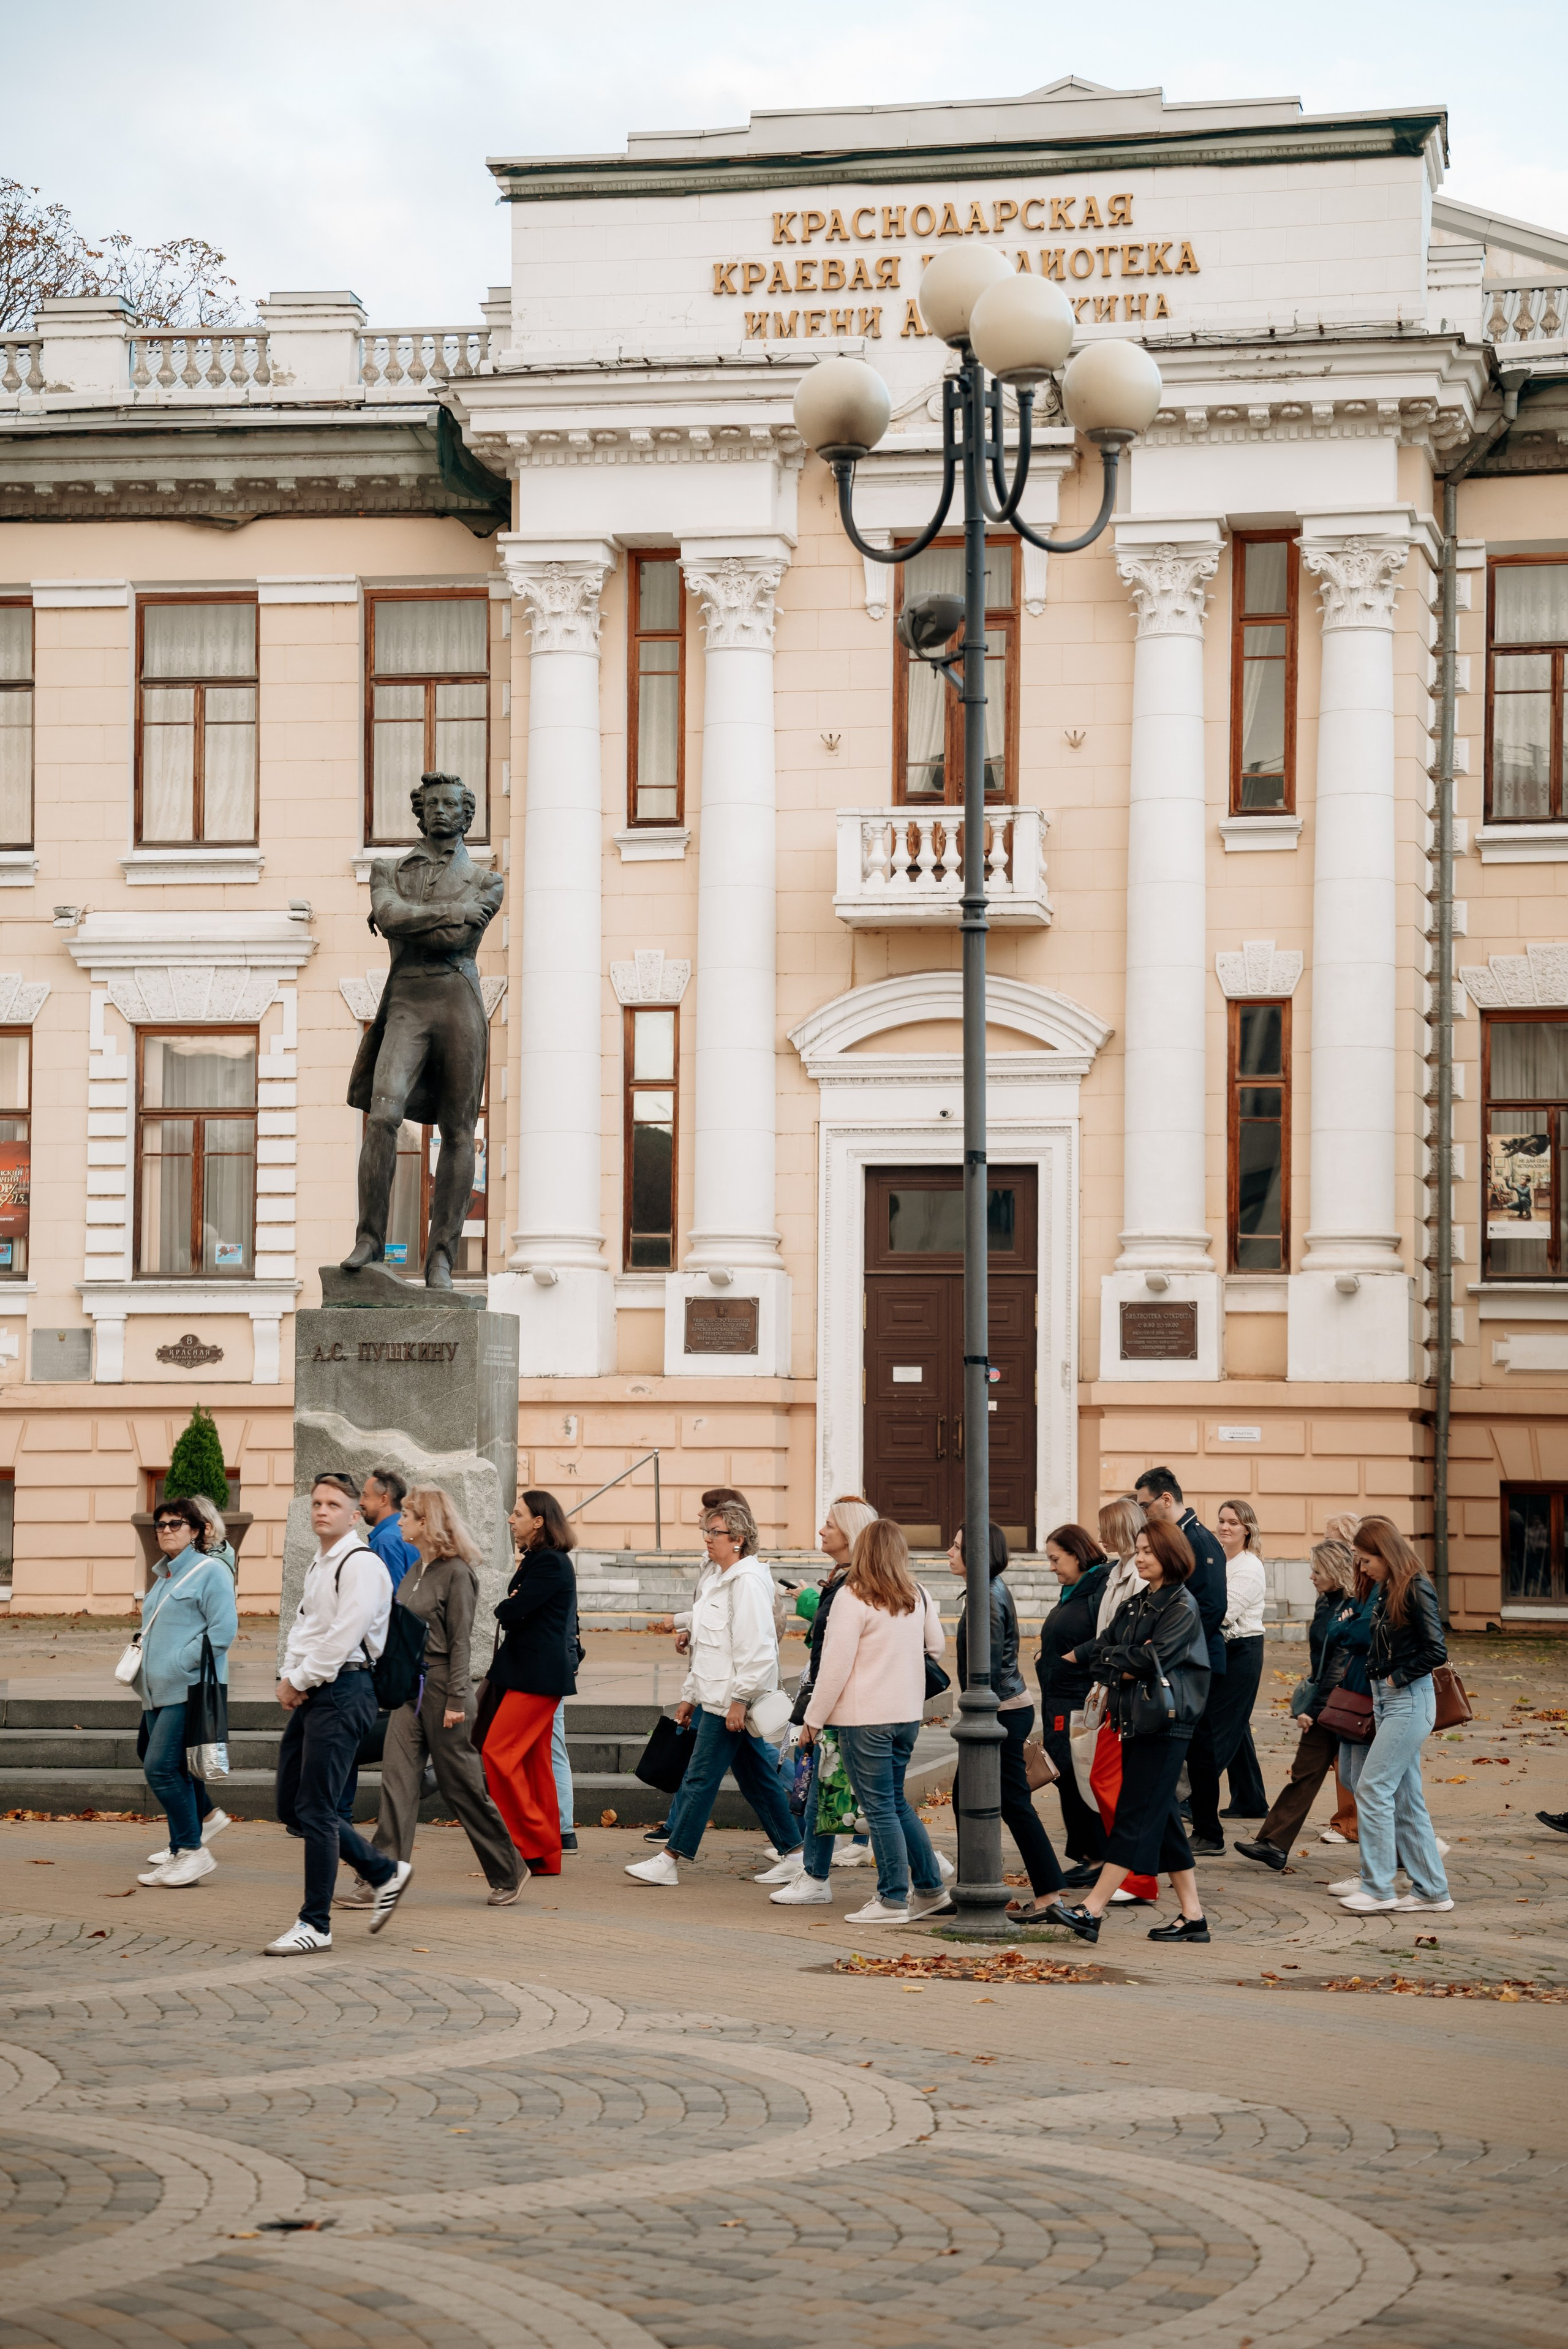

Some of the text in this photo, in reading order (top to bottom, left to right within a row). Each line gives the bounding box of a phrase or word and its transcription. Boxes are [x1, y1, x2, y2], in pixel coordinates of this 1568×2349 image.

[772, 193, 1134, 244] КРАСНОДАРСКАЯ
[712, 241, 1200, 295] КРАЕВАЯ ЛИОТЕКА
[744, 307, 883, 340] ИМЕНИ
[1068, 292, 1174, 325] КИНА
[186, 1336, 193, 1345] 8
[313, 1342, 347, 1361] А.С.
[358, 1341, 459, 1362] ПУШКИНУ
